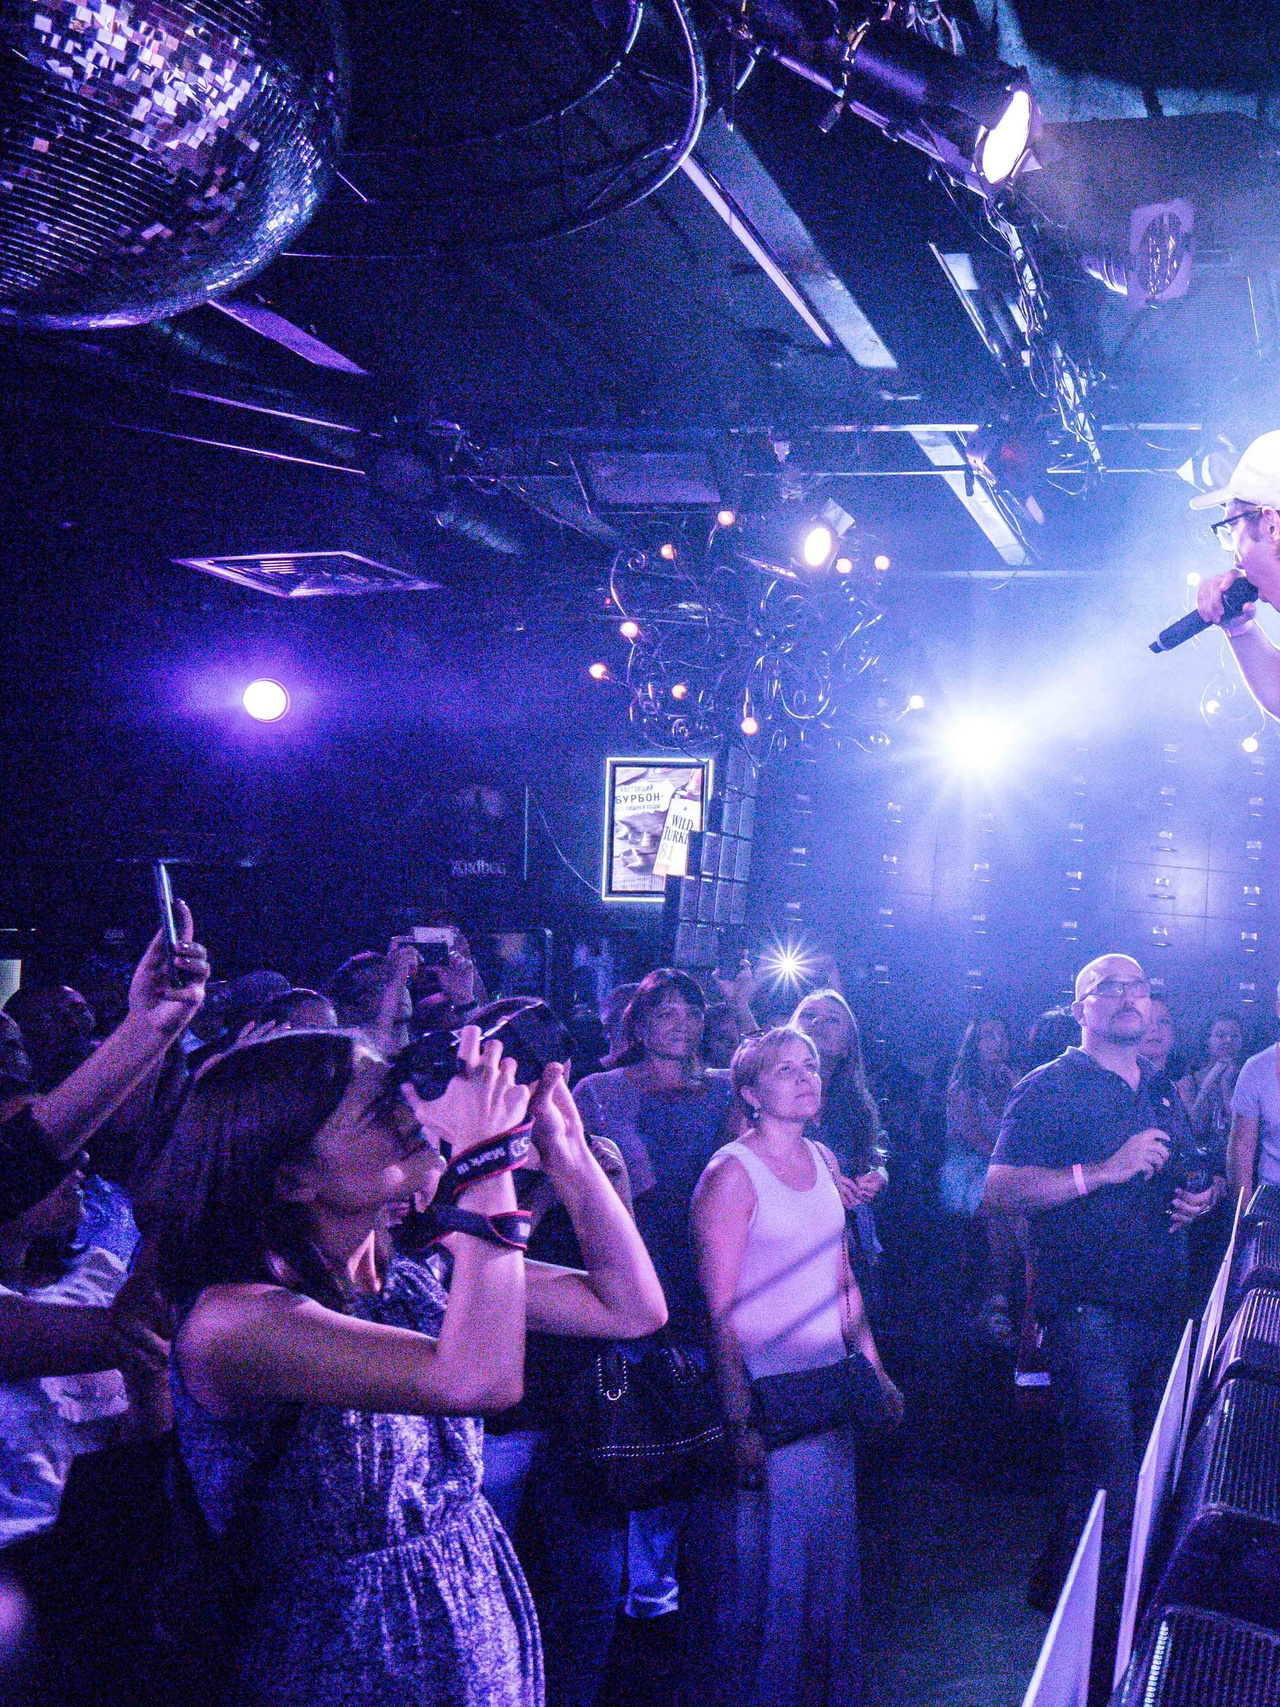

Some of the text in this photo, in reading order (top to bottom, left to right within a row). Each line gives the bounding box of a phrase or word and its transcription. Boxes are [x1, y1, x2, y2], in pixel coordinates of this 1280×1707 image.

[615, 793, 660, 804] БУРБОН
[672, 814, 694, 830] WILD
[664, 826, 688, 844] TURK
